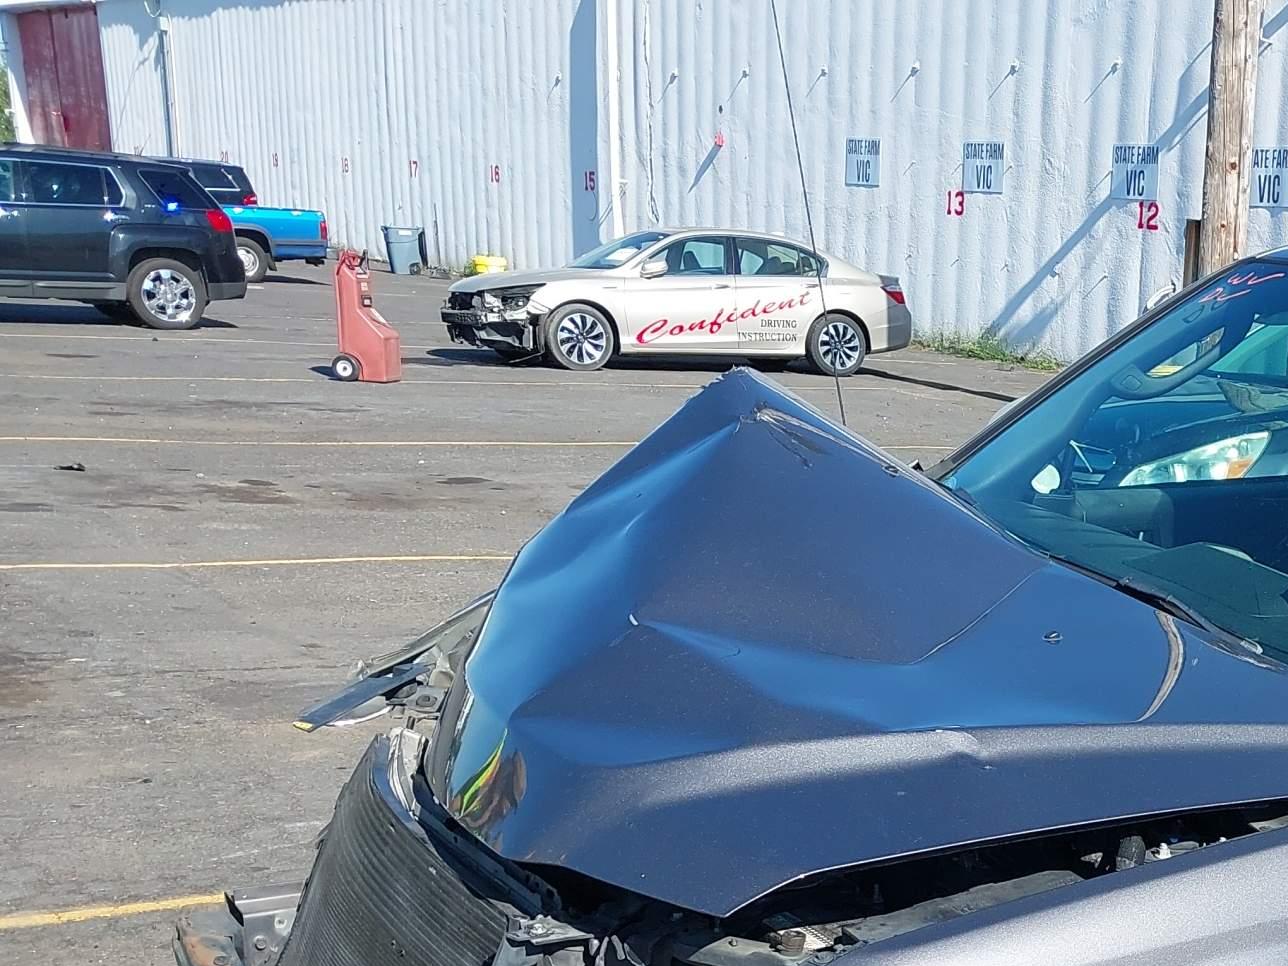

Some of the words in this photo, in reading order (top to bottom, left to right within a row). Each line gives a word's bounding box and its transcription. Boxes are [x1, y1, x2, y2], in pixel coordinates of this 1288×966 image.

[848, 140, 863, 155] STATE
[864, 140, 880, 155] FARM
[965, 143, 984, 160] STATE
[985, 143, 1004, 160] FARM
[1114, 146, 1136, 164] STATE
[1137, 146, 1159, 165] FARM
[341, 158, 349, 173] 18
[1252, 149, 1270, 168] ATE
[408, 160, 418, 178] 17
[490, 164, 500, 183] 16
[856, 160, 871, 182] VIC
[976, 165, 992, 189] VIC
[584, 171, 595, 191] 15
[1125, 170, 1145, 196] VIC
[1258, 175, 1280, 204] VIC
[946, 190, 964, 215] 13
[1137, 201, 1159, 230] 12
[636, 291, 810, 343] Confident
[760, 319, 797, 329] DRIVING
[738, 331, 798, 342] INSTRUCTION
